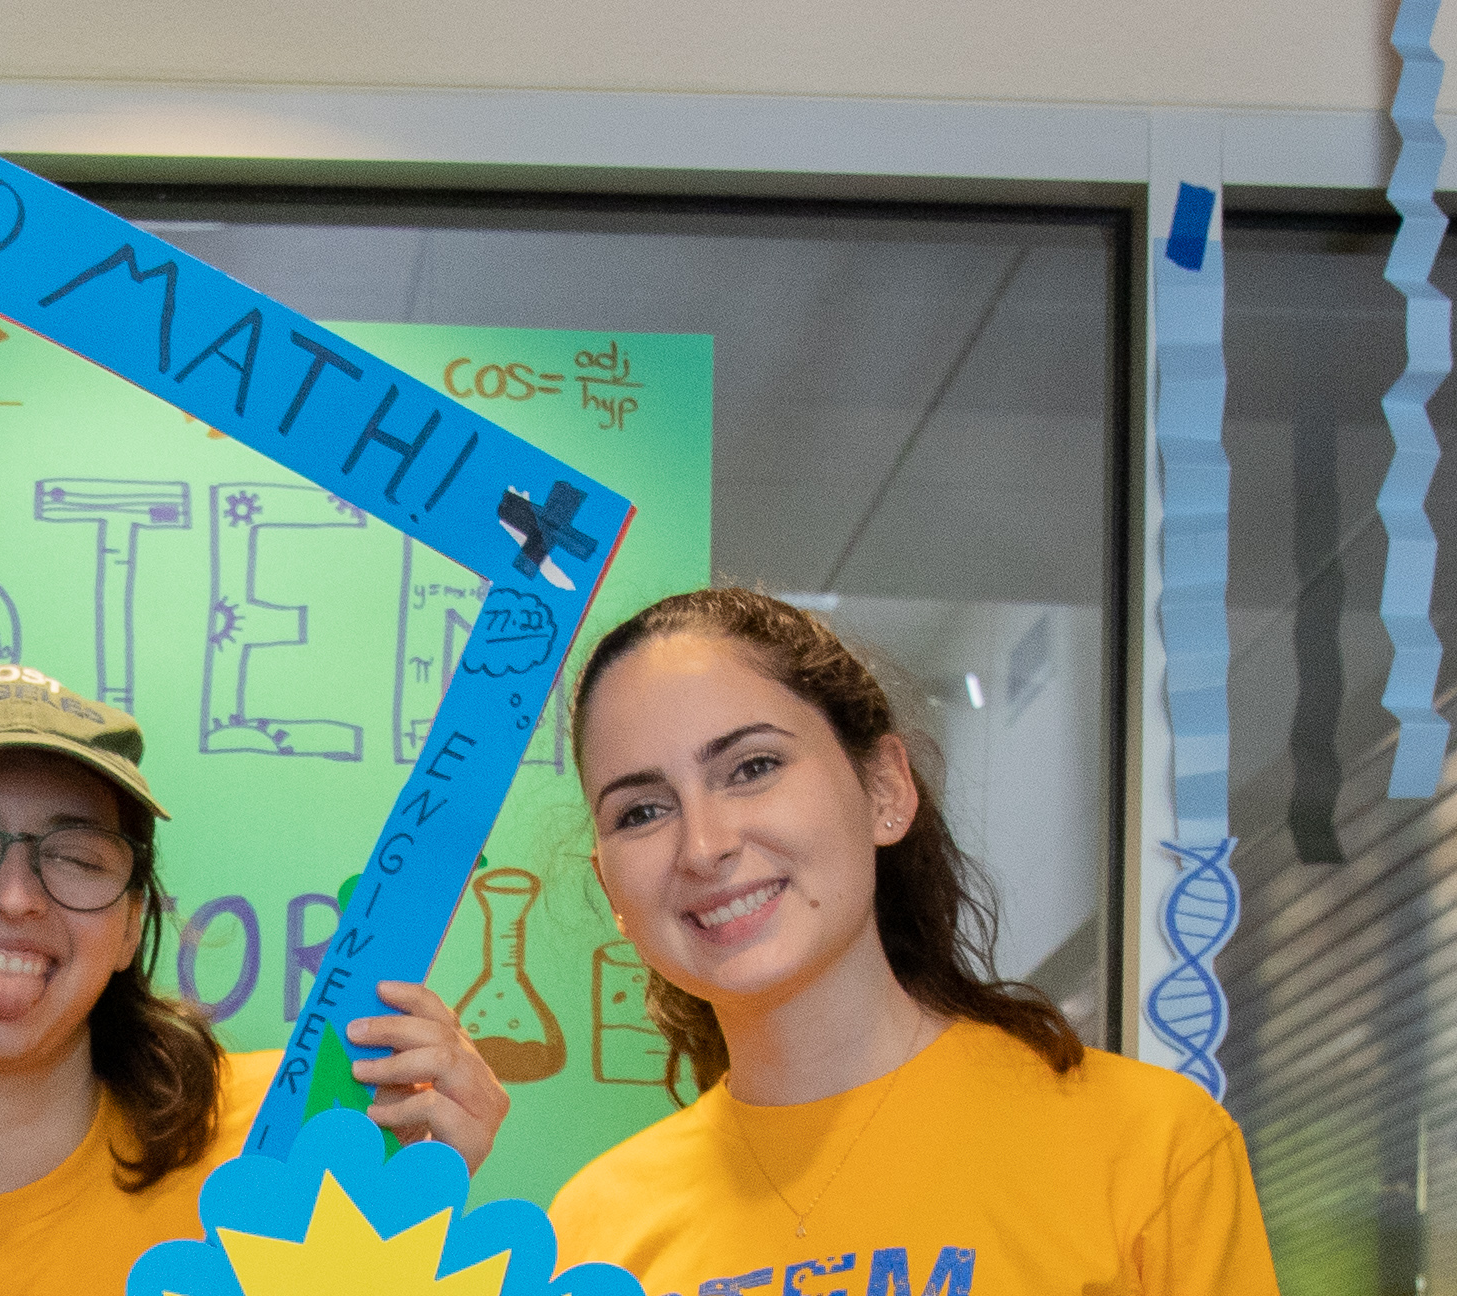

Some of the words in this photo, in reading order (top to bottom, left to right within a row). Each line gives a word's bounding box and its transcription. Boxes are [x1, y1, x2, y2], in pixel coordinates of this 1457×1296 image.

[38, 243, 478, 522] MATH!
[160, 893, 343, 1025] OR
[258, 731, 477, 1150] ENGINEERI
